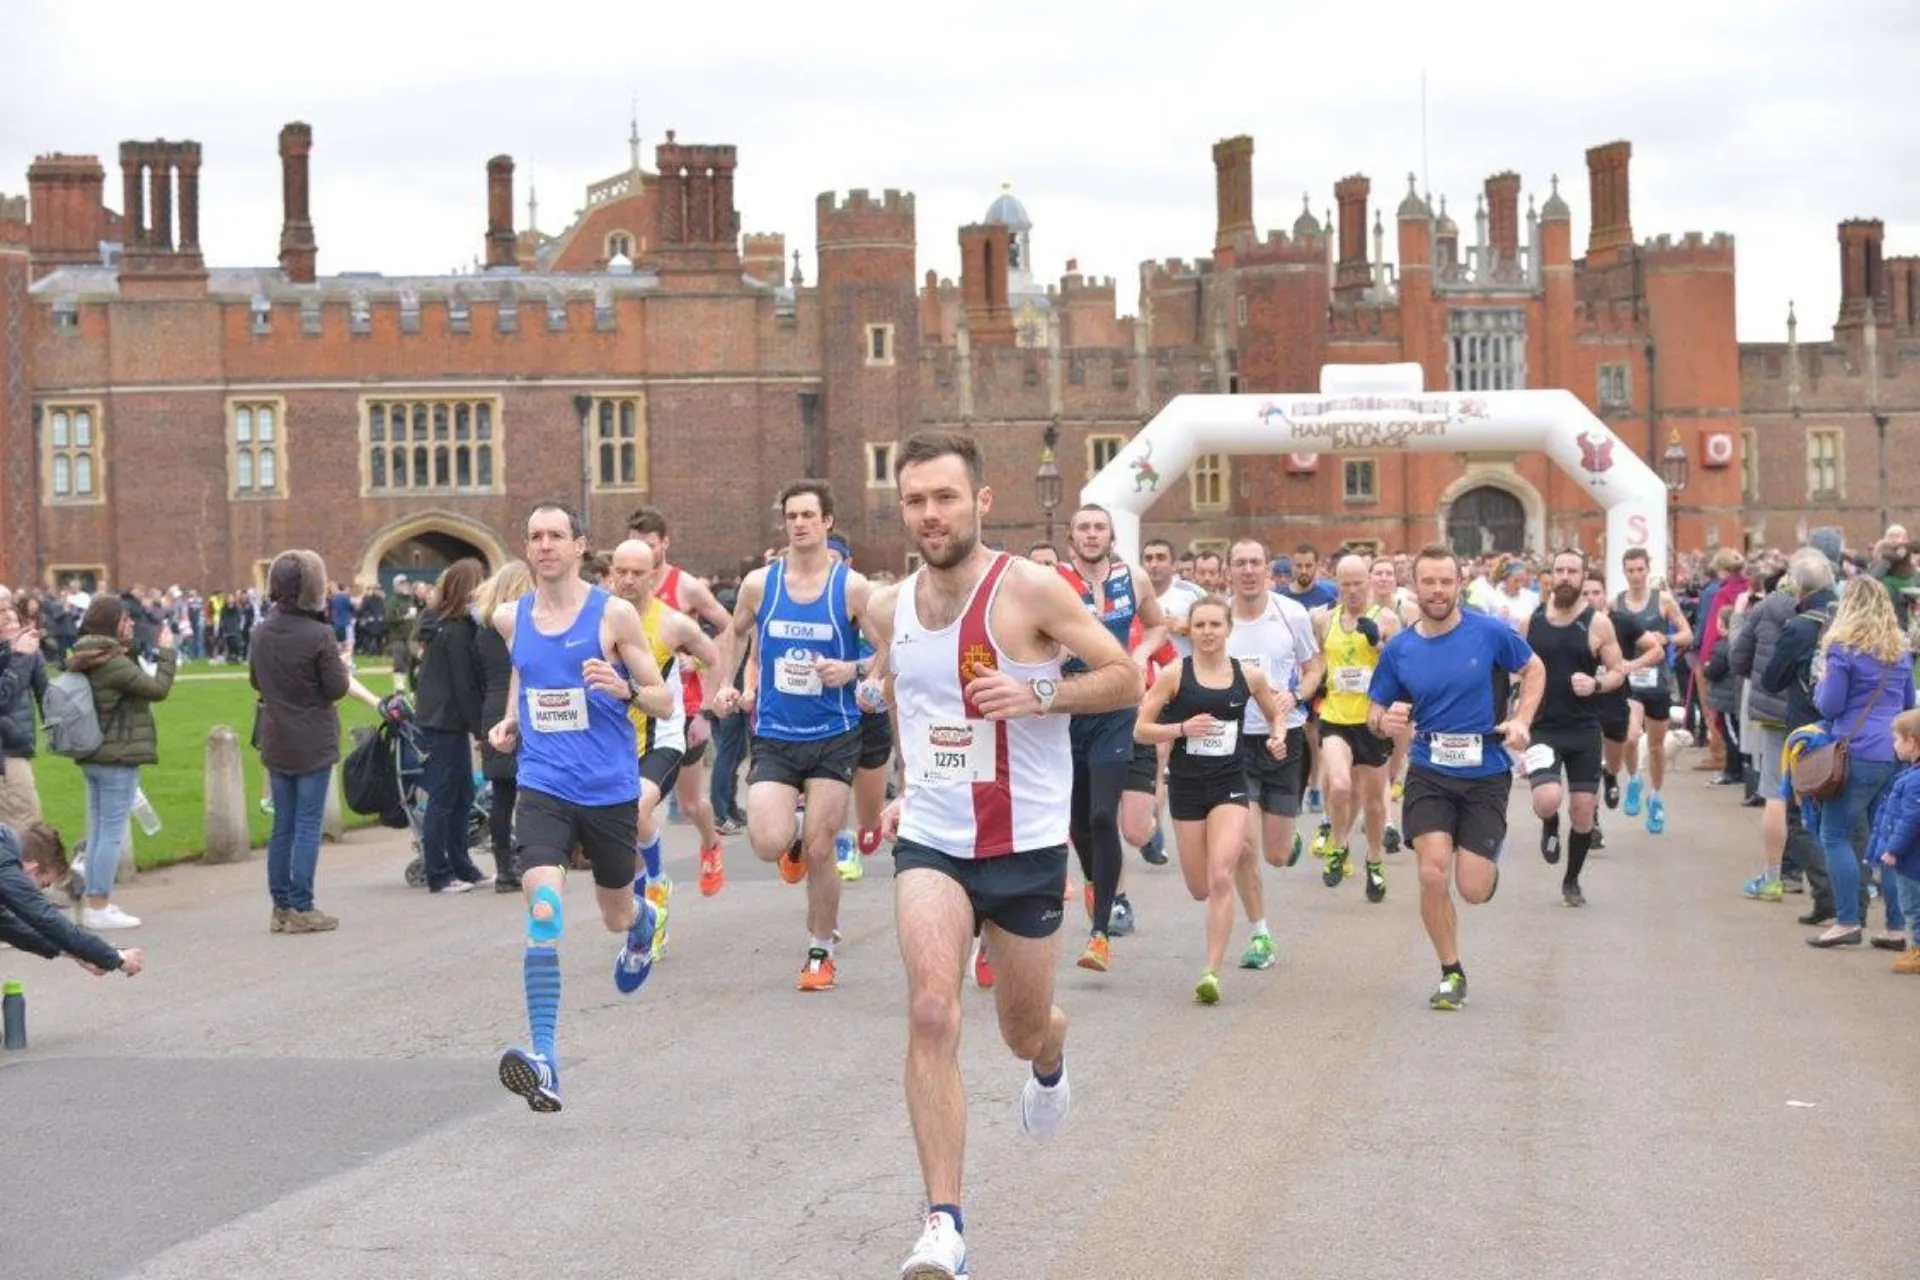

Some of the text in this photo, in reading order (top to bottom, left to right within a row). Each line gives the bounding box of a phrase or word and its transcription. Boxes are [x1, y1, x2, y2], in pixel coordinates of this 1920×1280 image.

[1291, 420, 1447, 438] HAMPTON COURT
[784, 624, 815, 637] TOM
[536, 709, 578, 722] MATTHEW
[934, 752, 967, 768] 12751
